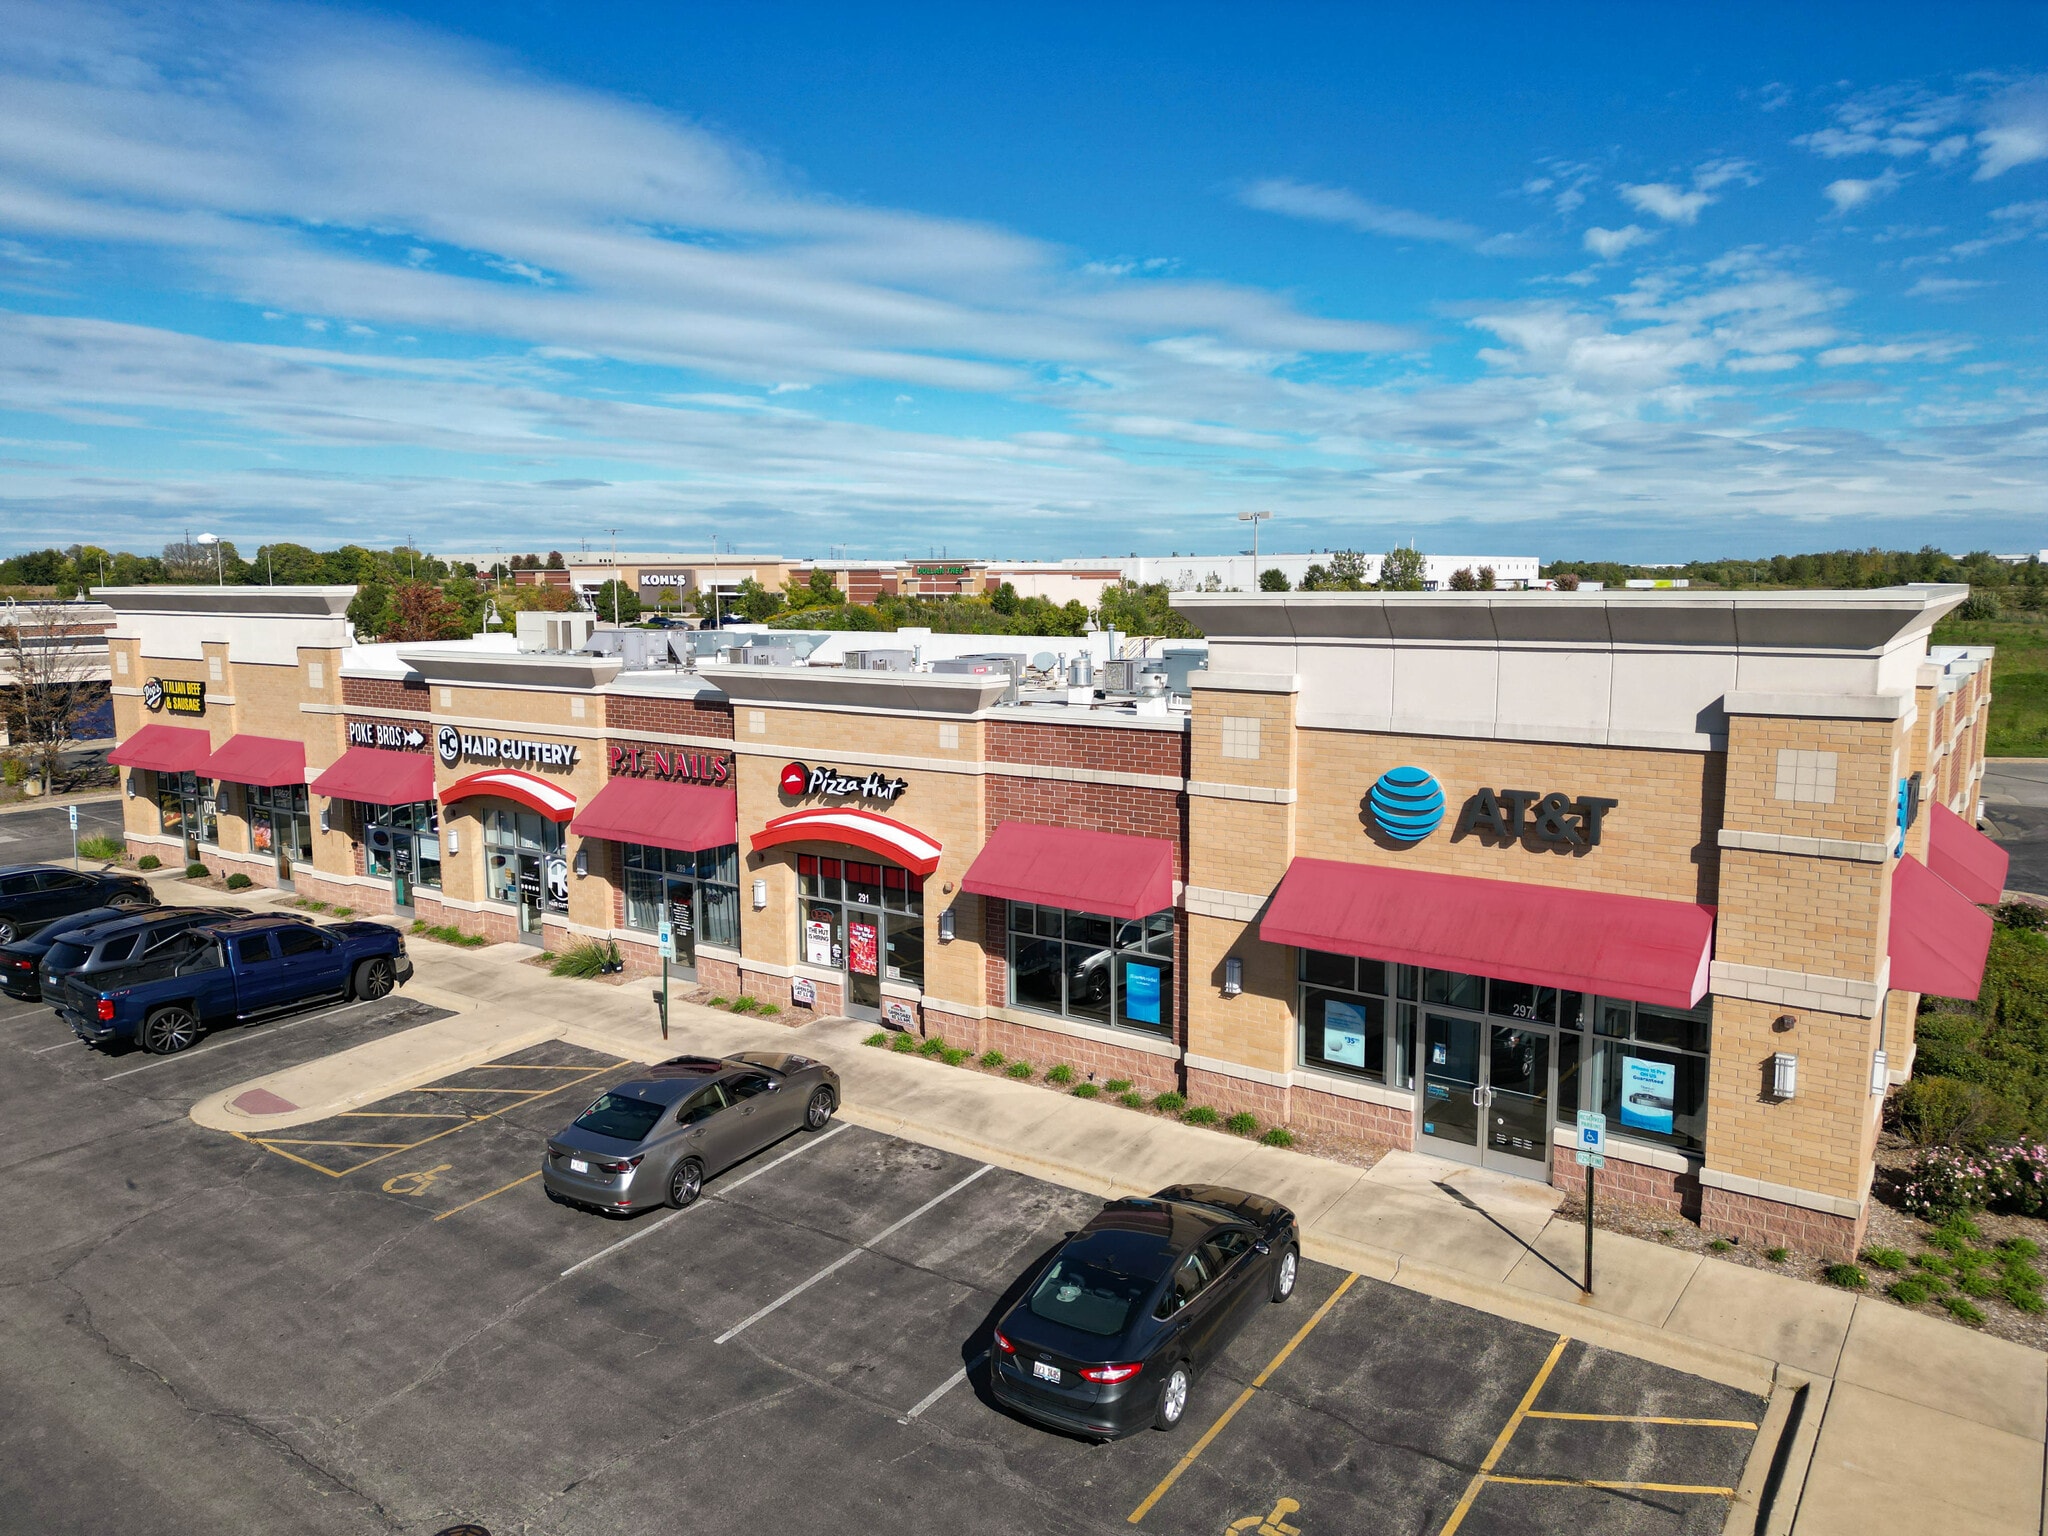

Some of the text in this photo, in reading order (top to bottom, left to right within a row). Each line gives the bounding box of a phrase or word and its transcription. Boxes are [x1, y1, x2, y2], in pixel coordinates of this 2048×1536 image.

[917, 567, 964, 575] DOLLAR TREE
[641, 575, 686, 586] KOHL'S
[144, 683, 161, 700] Pop's
[163, 681, 201, 695] ITALIAN BEEF
[166, 697, 201, 711] & SAUSAGE
[349, 722, 401, 747] POKE BROS
[462, 735, 574, 765] HAIR CUTTERY
[610, 746, 727, 780] P.T. NAILS
[808, 769, 902, 800] Pizza Hut
[1464, 787, 1619, 846] AT&T
[858, 893, 869, 903] 291
[808, 926, 829, 936] THE HUT
[813, 934, 829, 942] HIRING
[1513, 1004, 1533, 1017] 297
[1632, 1075, 1664, 1085] Guaranteed
